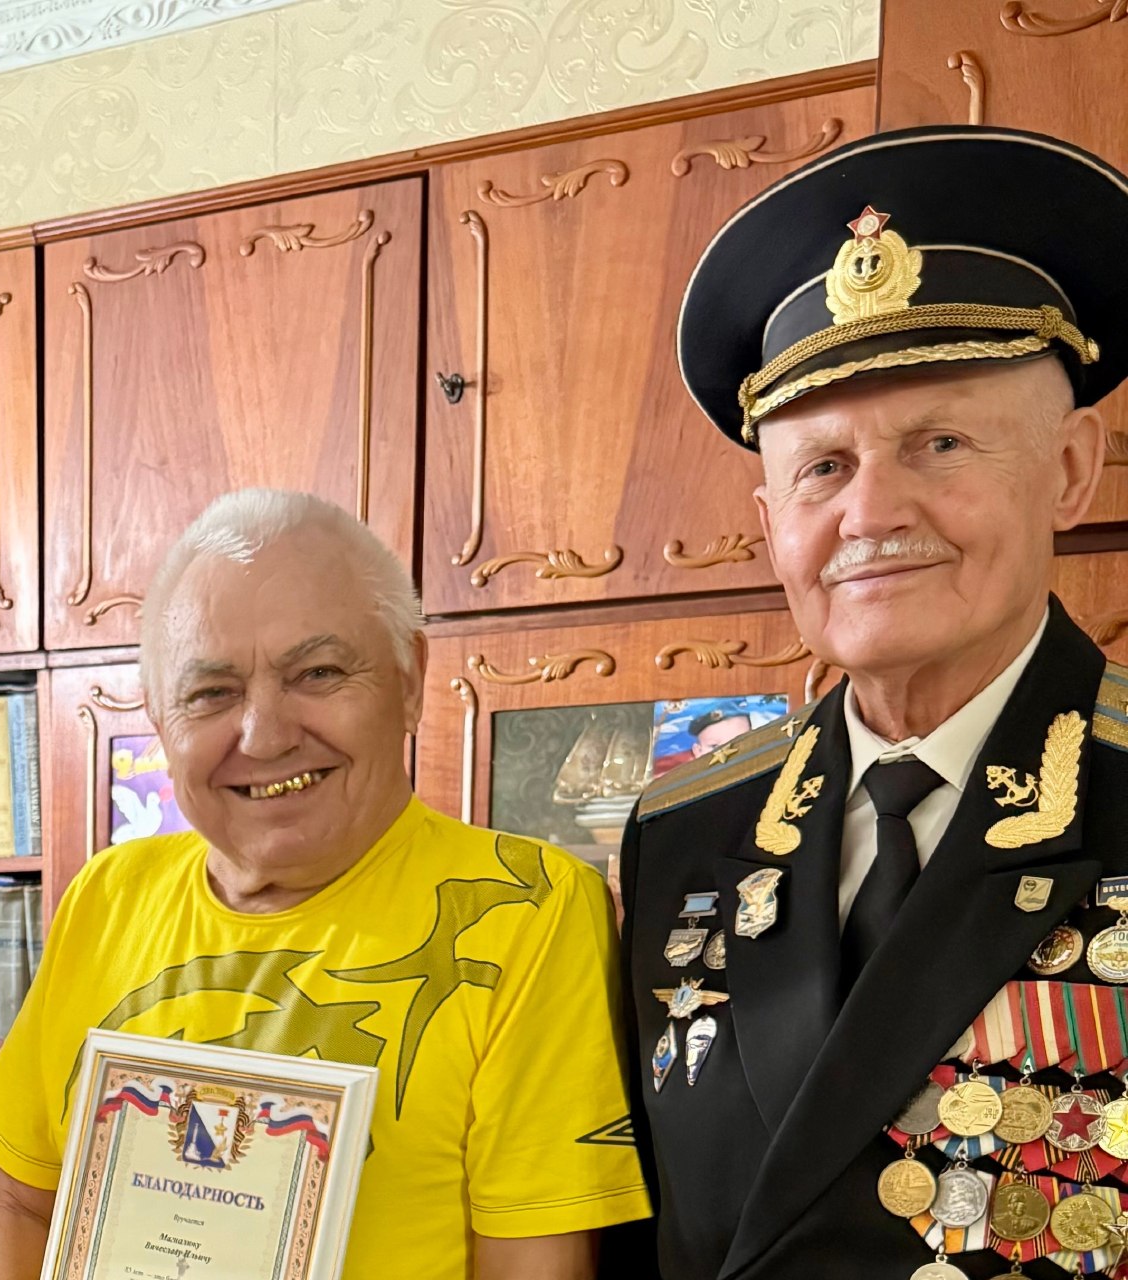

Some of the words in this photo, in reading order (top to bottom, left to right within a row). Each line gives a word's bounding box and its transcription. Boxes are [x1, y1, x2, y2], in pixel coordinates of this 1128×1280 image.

[132, 1172, 265, 1211] БЛАГОДАРНОСТЬ
[144, 1241, 183, 1257] Вячеславу
[183, 1249, 212, 1264] Ильичу
